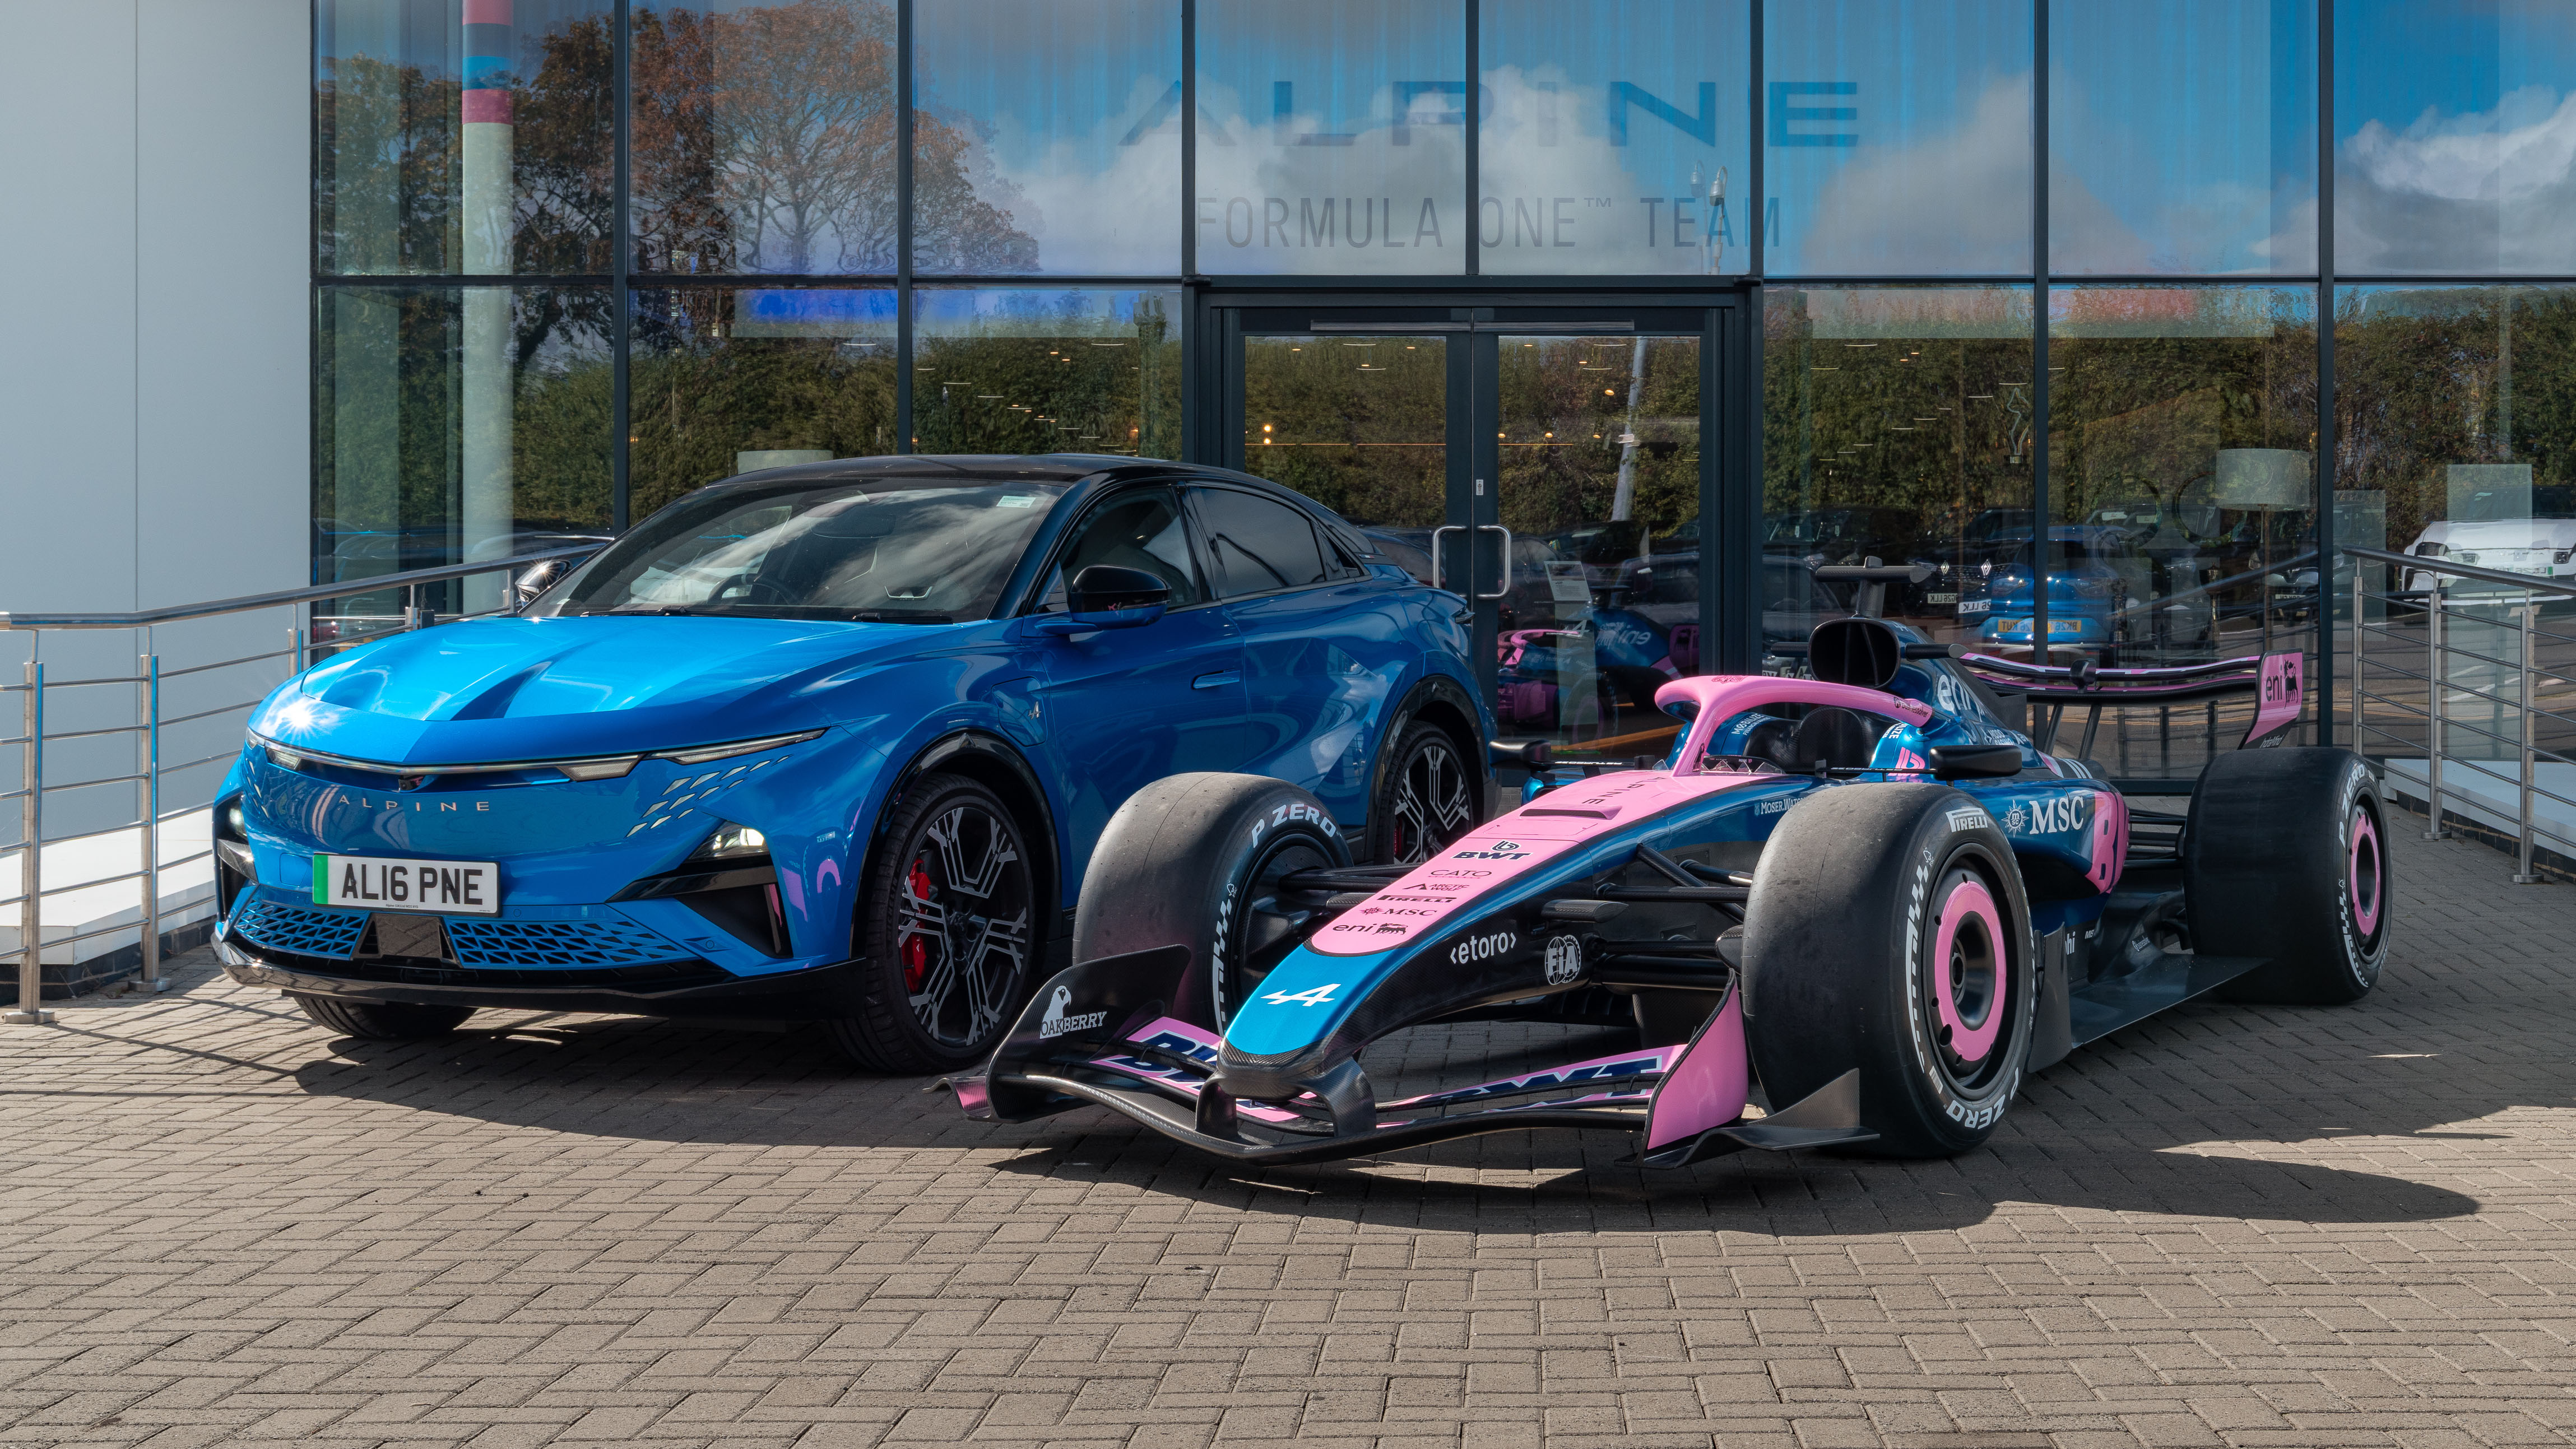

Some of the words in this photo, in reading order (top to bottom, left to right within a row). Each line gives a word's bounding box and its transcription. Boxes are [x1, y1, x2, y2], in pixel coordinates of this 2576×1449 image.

[1117, 80, 1859, 147] ALPINE
[1196, 197, 1444, 248] FORMULA
[1640, 197, 1780, 248] TEAM
[2266, 664, 2283, 702] eni
[338, 795, 490, 812] ALPINE
[2342, 764, 2365, 819] ZERO
[1251, 818, 1265, 849] P
[1272, 804, 1336, 838] ZERO
[1945, 807, 1988, 833] PIRELLI
[2029, 796, 2084, 835] MSC
[1450, 851, 1533, 861] BWT
[341, 863, 409, 902] AL16
[419, 867, 483, 905] PNE
[1332, 923, 1377, 933] eni
[1382, 908, 1438, 917] MSC
[1041, 1011, 1107, 1037] OAKBERRY
[1946, 1094, 2006, 1130] ZERO
